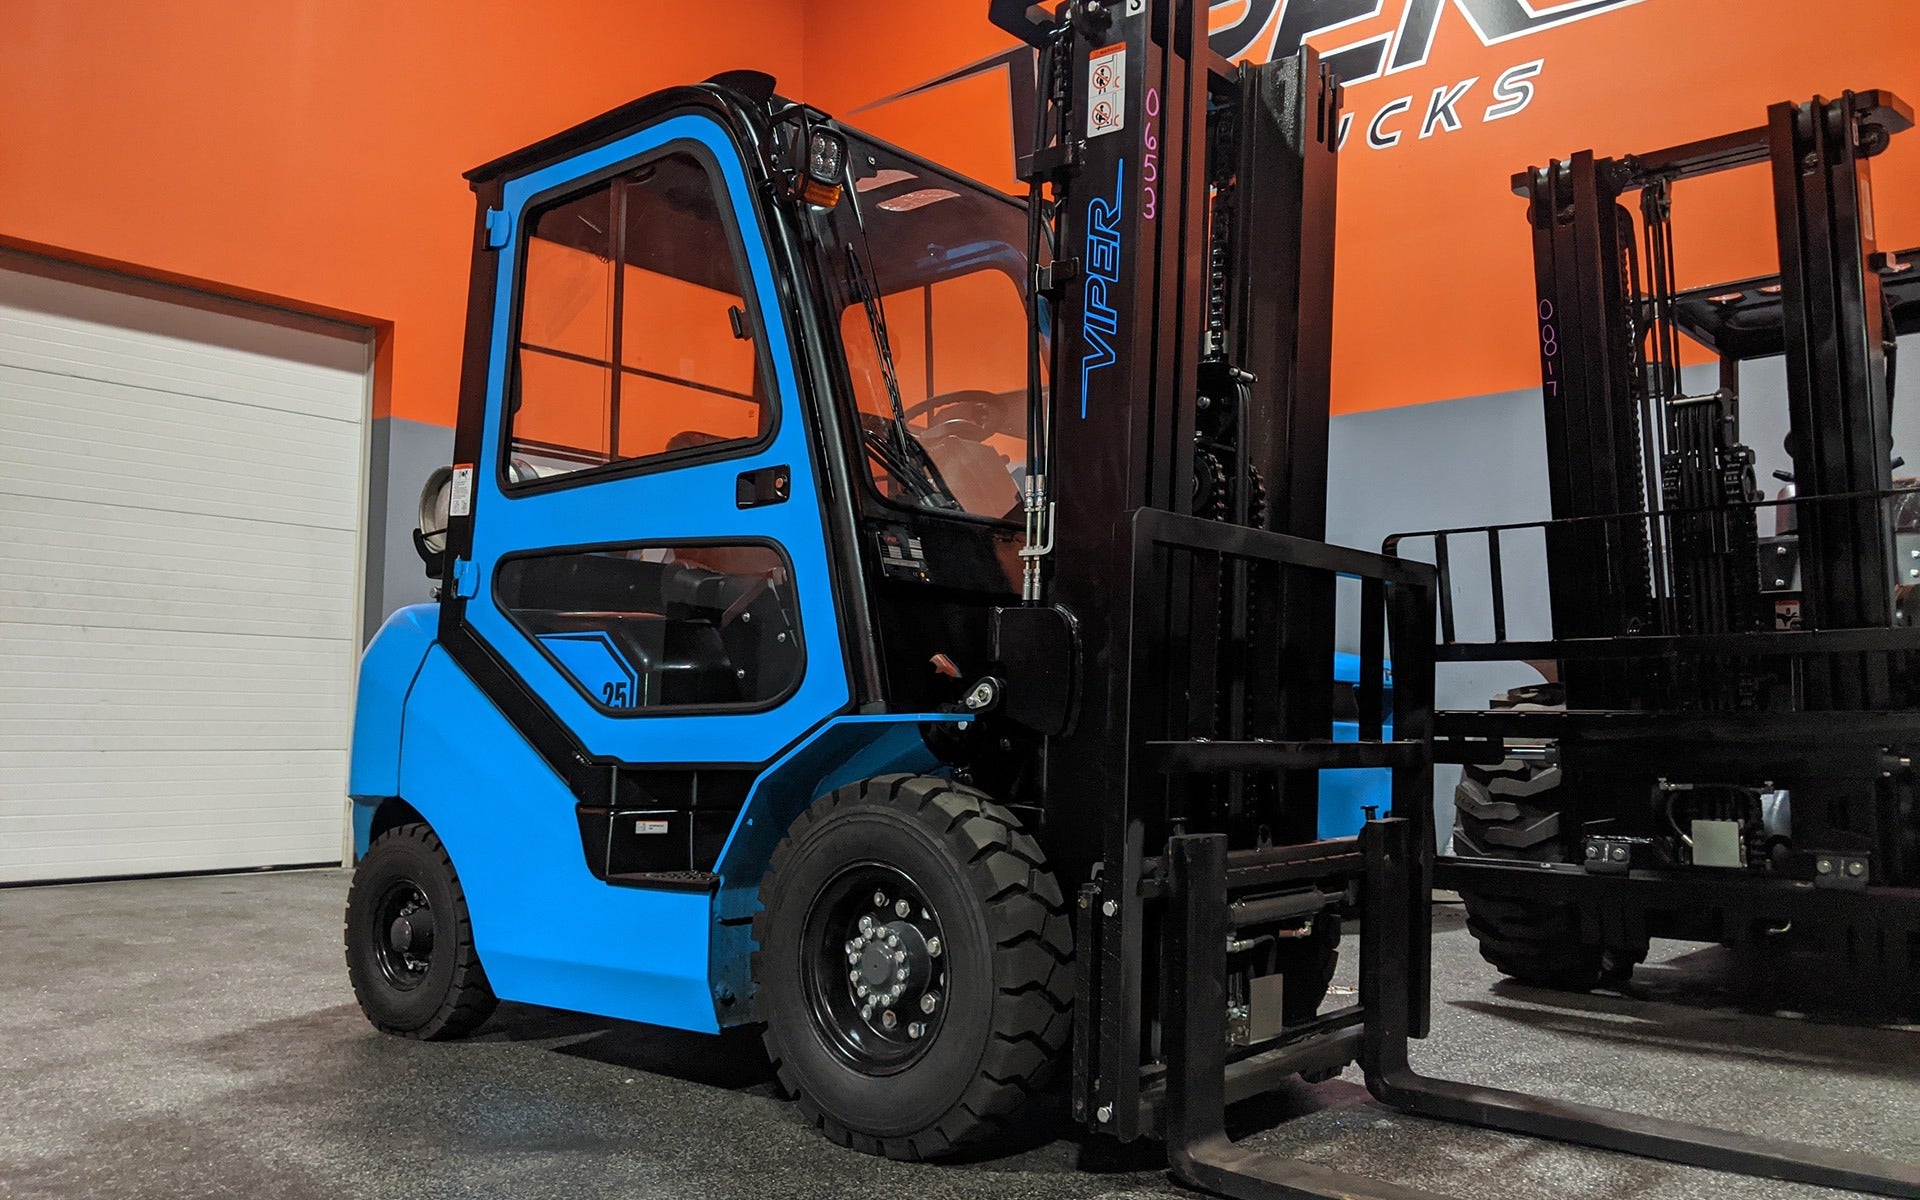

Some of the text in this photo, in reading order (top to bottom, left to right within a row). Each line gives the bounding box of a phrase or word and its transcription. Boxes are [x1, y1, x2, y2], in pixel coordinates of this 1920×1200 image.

[1143, 87, 1160, 220] 0653
[1082, 158, 1124, 420] VIPER
[1539, 298, 1558, 397] 0817
[602, 681, 628, 708] 25
